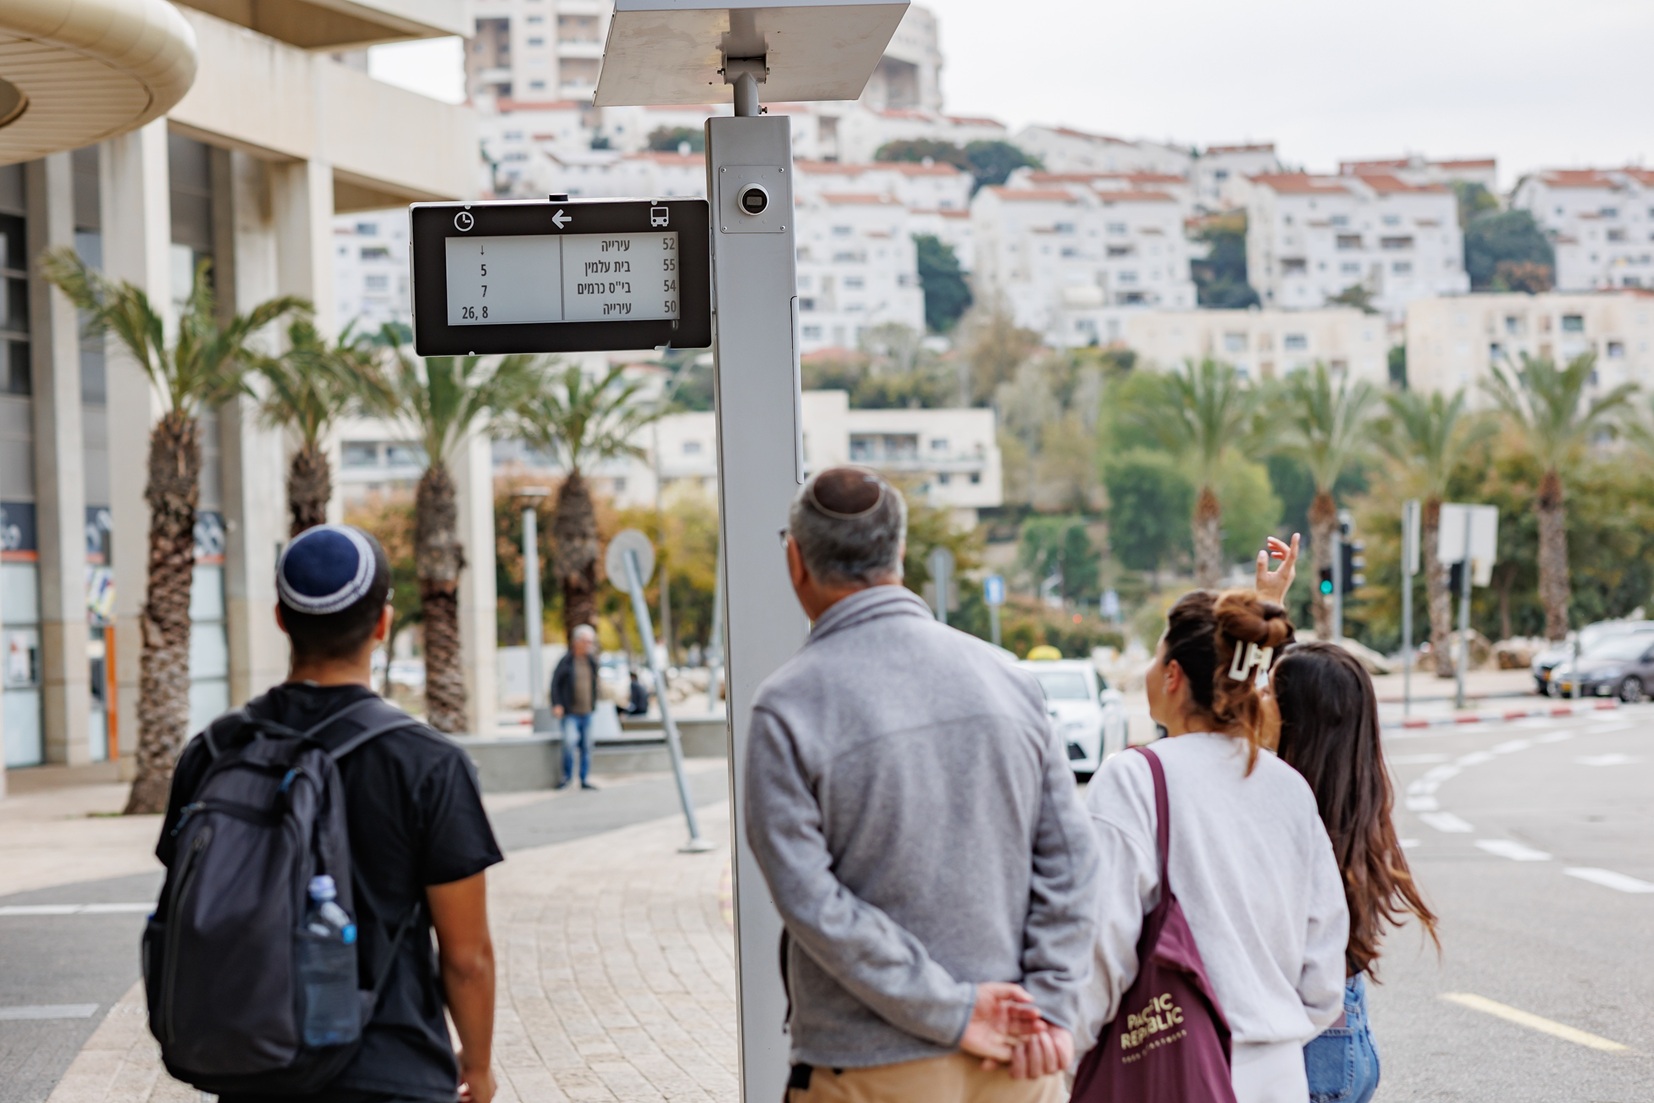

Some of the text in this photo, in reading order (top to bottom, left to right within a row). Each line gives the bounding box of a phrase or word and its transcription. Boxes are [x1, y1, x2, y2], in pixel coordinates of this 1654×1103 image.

[601, 237, 675, 252] 52 עירייה
[481, 264, 487, 277] 5
[585, 258, 676, 277] 55 בית עלמין
[481, 285, 488, 298] 7
[577, 282, 605, 295] כרמים
[663, 279, 677, 292] 54
[482, 305, 489, 319] 8
[603, 300, 677, 315] 50 עירייה
[1120, 1006, 1184, 1050] REPBLIC
